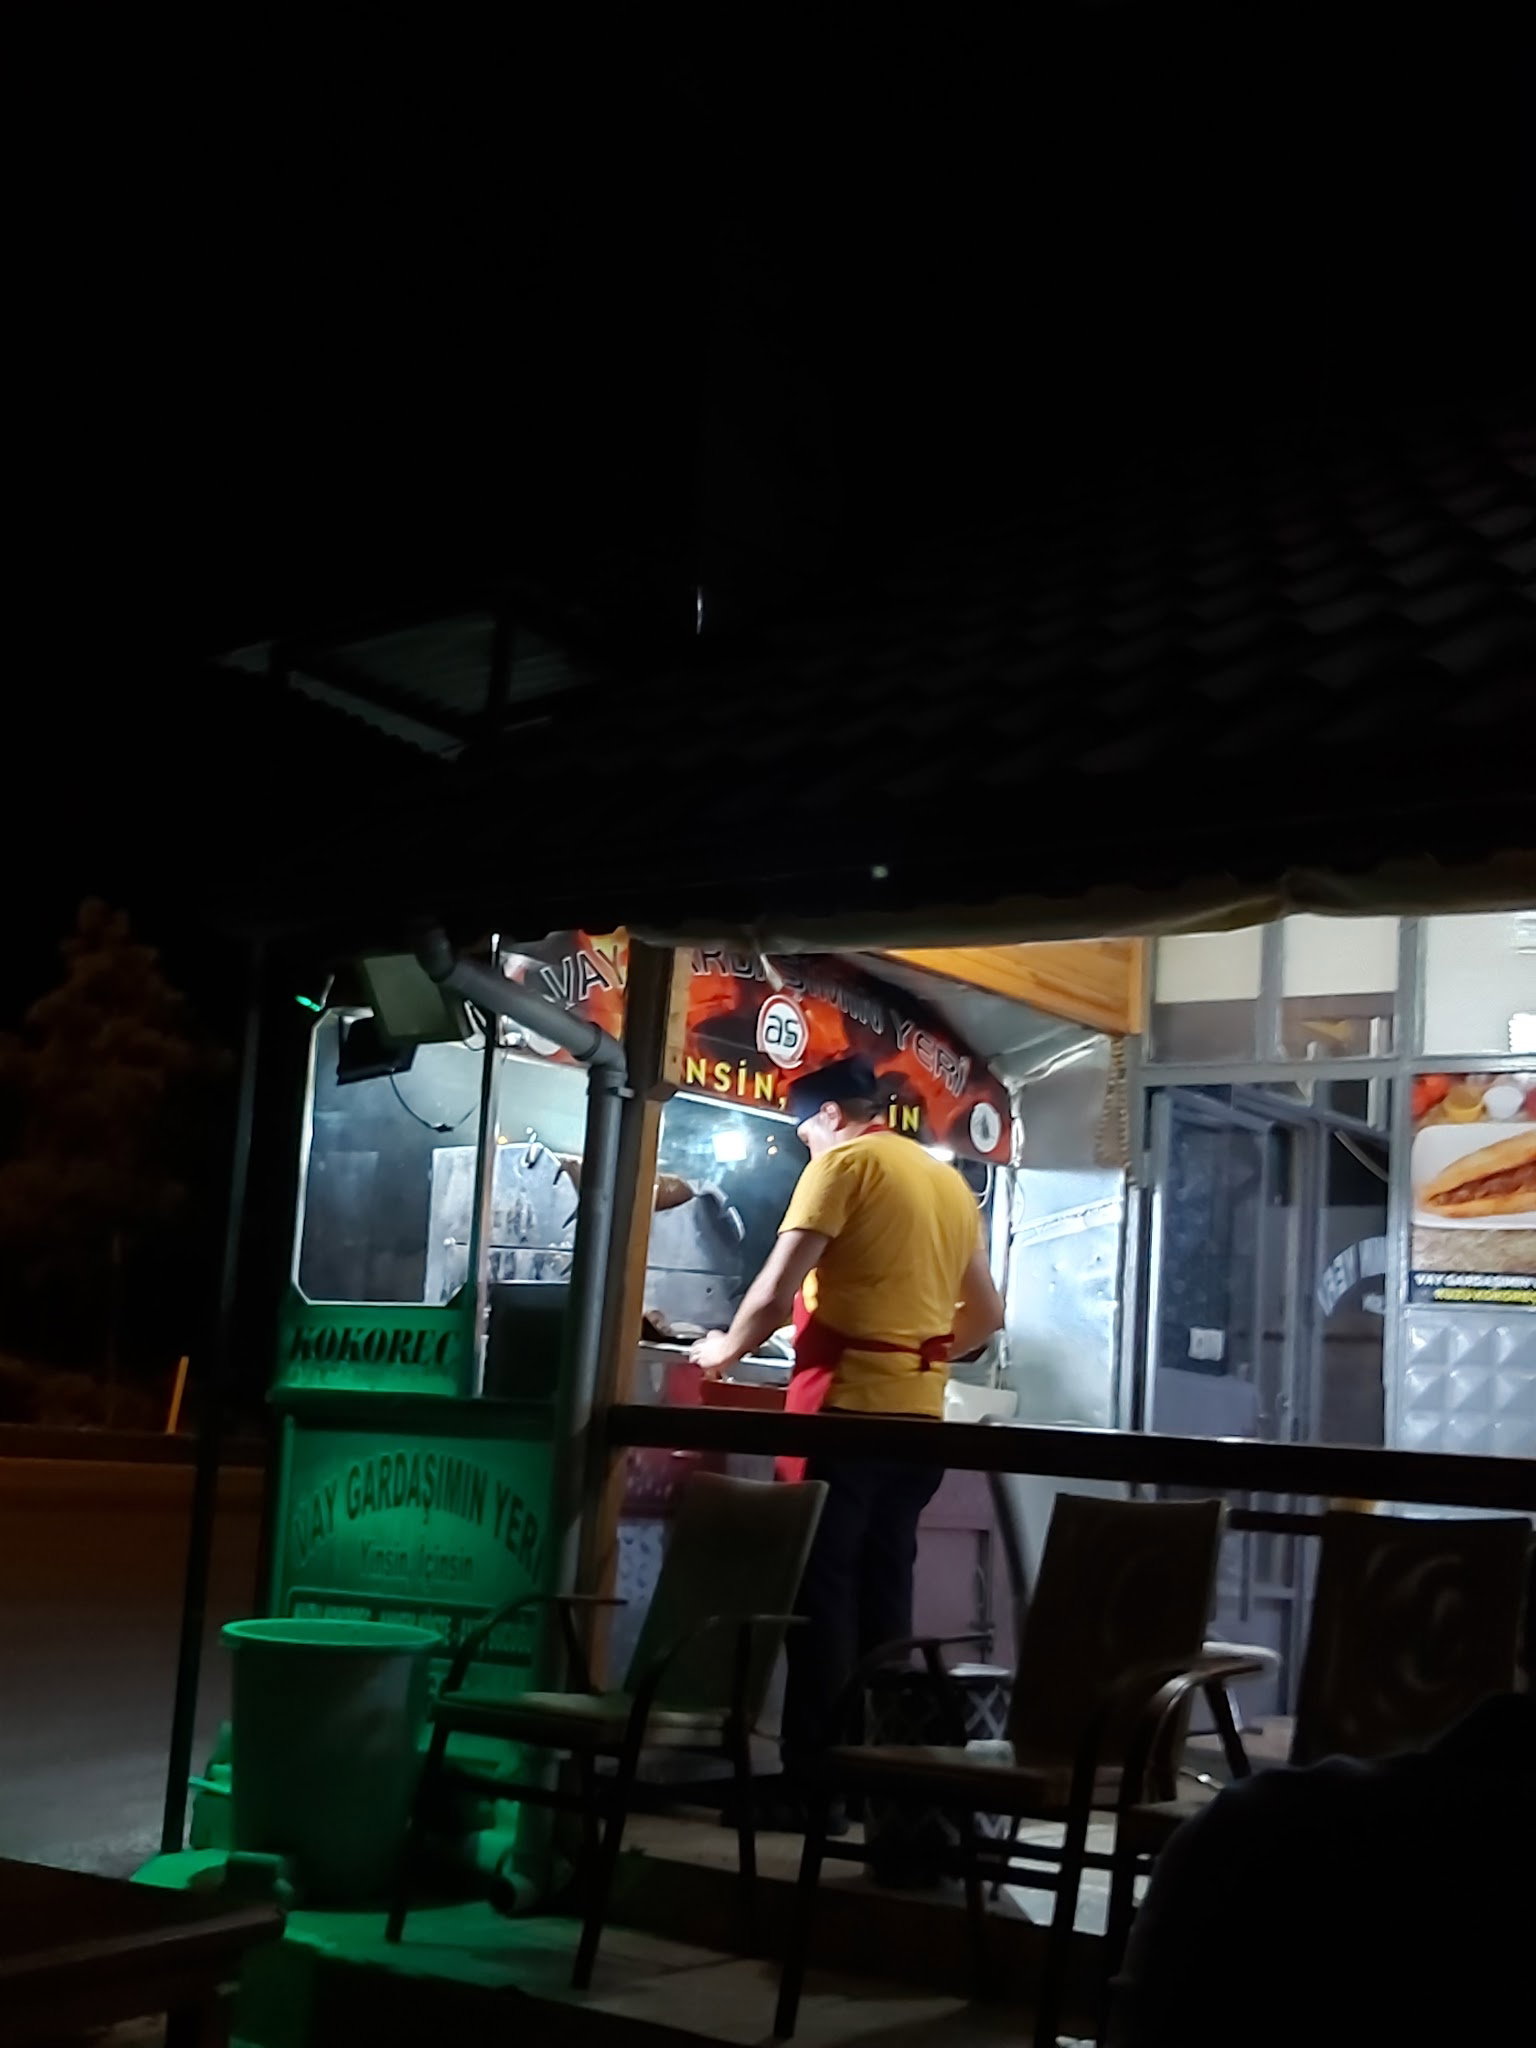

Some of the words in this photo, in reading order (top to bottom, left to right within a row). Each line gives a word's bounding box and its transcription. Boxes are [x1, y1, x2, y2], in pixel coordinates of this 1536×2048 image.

[540, 944, 628, 1004] VAY
[685, 1056, 788, 1111] NSİN,
[293, 1476, 339, 1562] VAY
